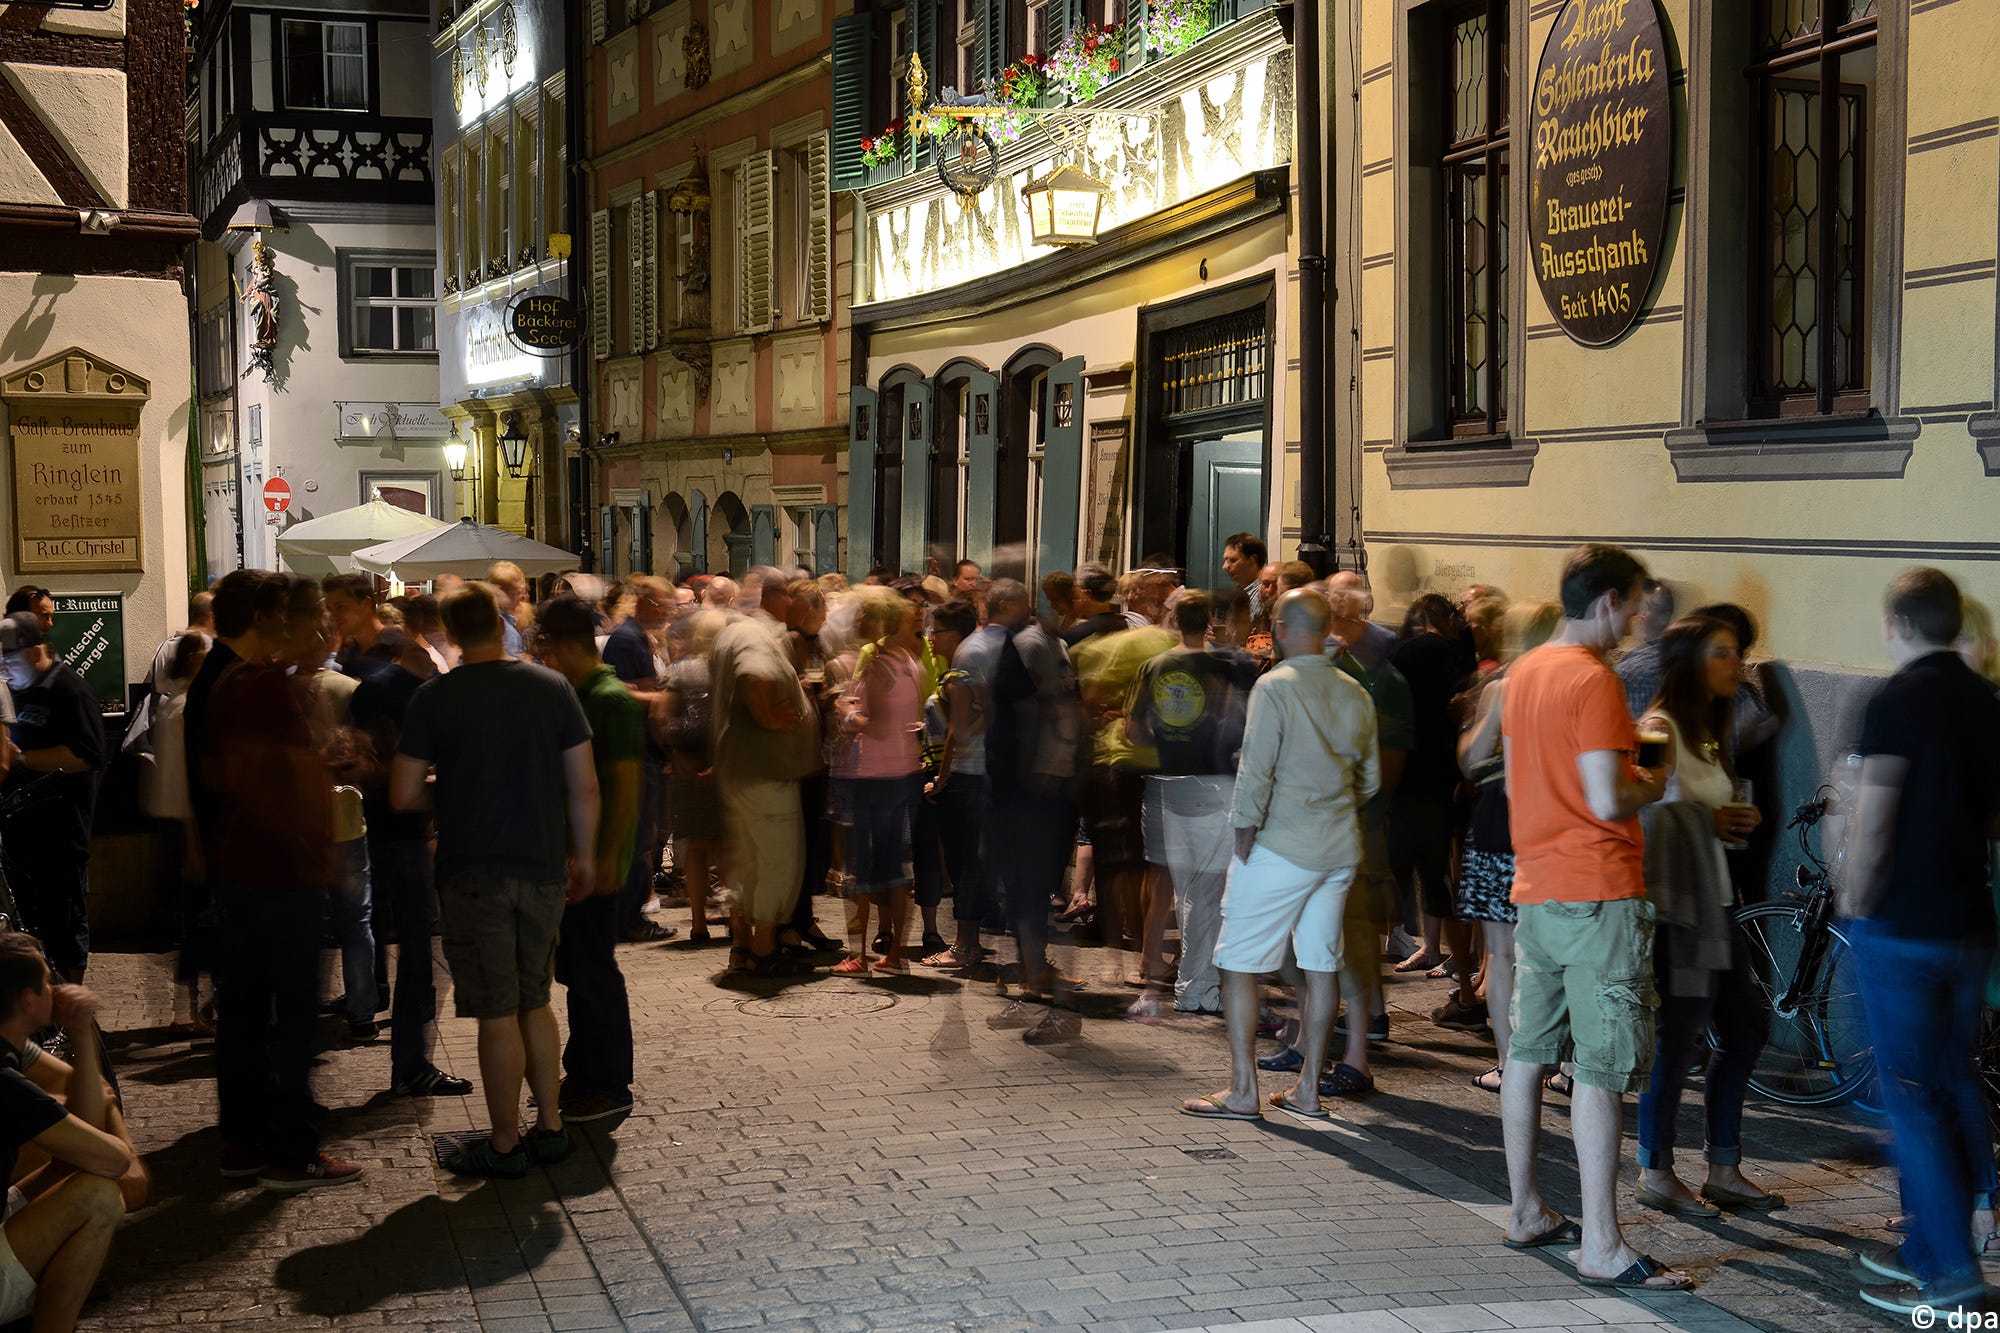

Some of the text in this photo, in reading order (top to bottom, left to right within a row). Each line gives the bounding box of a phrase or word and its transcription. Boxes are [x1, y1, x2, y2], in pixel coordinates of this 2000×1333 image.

[1536, 34, 1656, 117] Schlenkerla
[1536, 98, 1649, 170] Rauchbier
[1546, 184, 1632, 235] Brauerei-
[1540, 228, 1648, 281] Ausschank
[1199, 257, 1208, 281] 6
[530, 299, 561, 316] Hof
[1561, 282, 1631, 320] Seit 1405
[517, 313, 577, 328] Bäckerei
[529, 329, 567, 345] Seel
[62, 416, 134, 437] Brauhaus
[62, 442, 92, 454] zum
[31, 462, 122, 490] Ringlein
[35, 493, 123, 509] erbaut 1545
[76, 540, 125, 557] Christel
[53, 598, 118, 612] lt-Ringlein
[75, 636, 110, 678] pargel
